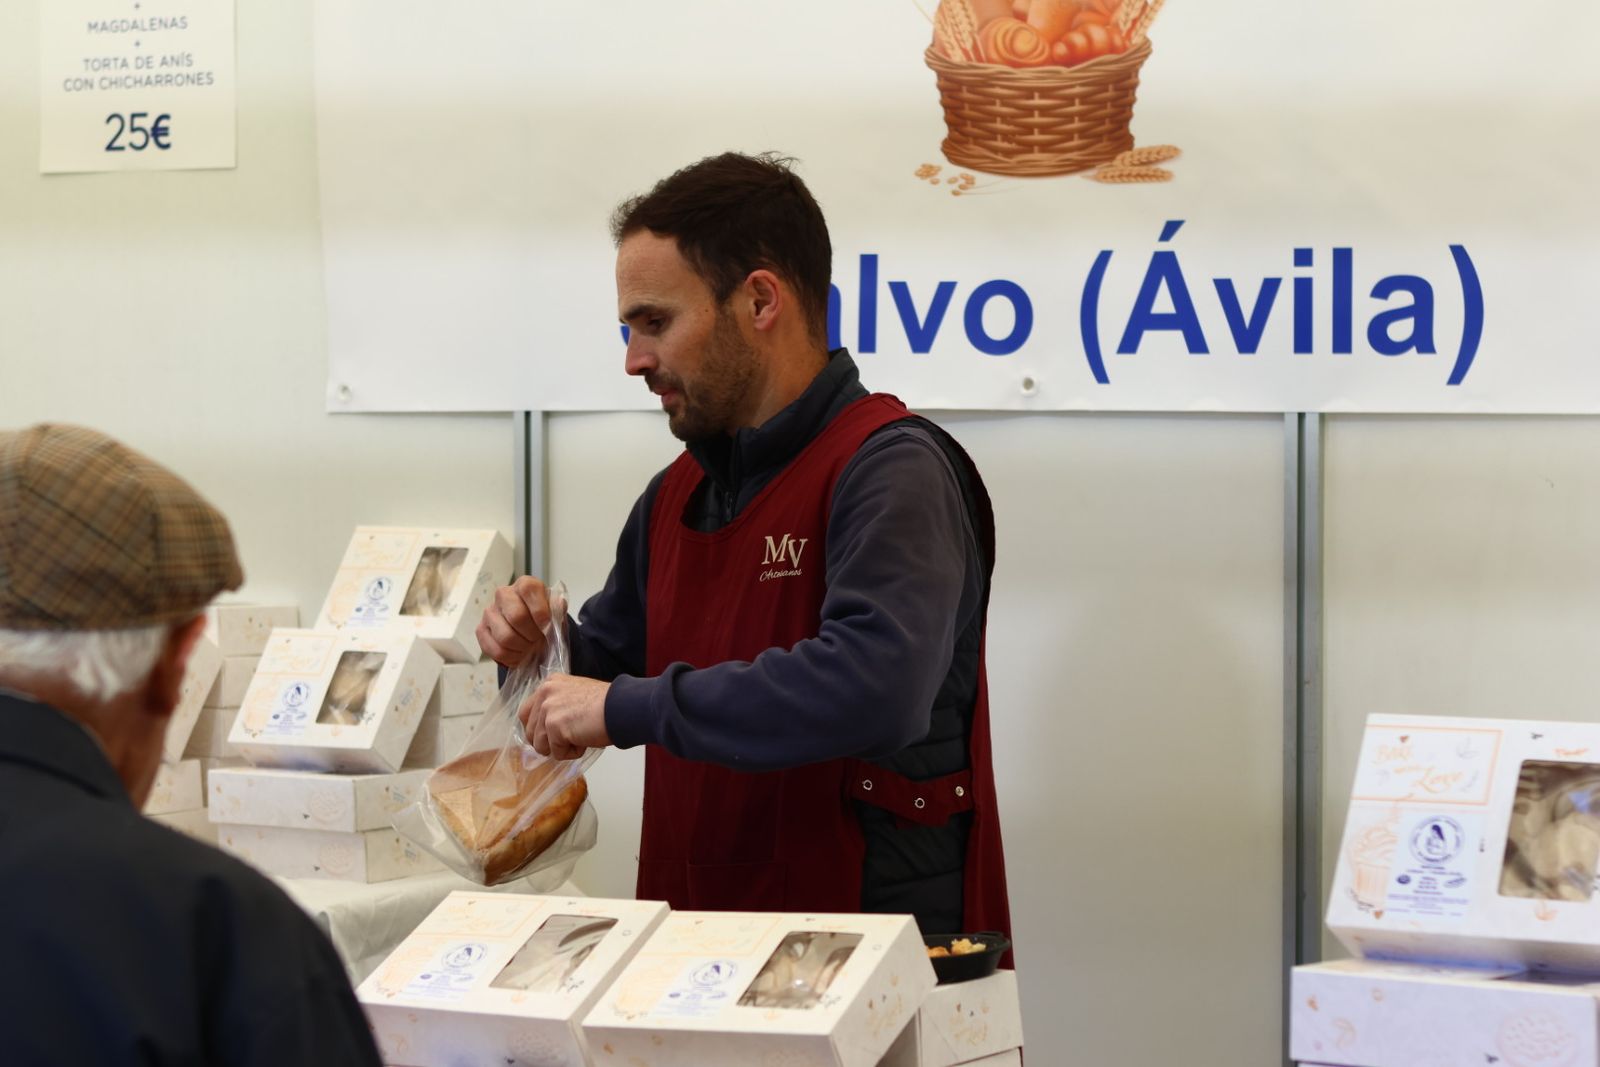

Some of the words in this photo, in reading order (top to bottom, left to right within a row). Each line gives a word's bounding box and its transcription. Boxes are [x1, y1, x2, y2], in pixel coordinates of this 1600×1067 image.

[87, 16, 188, 33] MAGDALENAS
[83, 57, 129, 72] TORTA
[135, 55, 154, 70] DE
[160, 52, 193, 68] ANÍS
[63, 77, 95, 92] CON
[99, 72, 214, 90] CHICHARRONES
[105, 112, 172, 152] 25€
[1080, 220, 1484, 385] (Ávila)
[761, 533, 808, 568] MV
